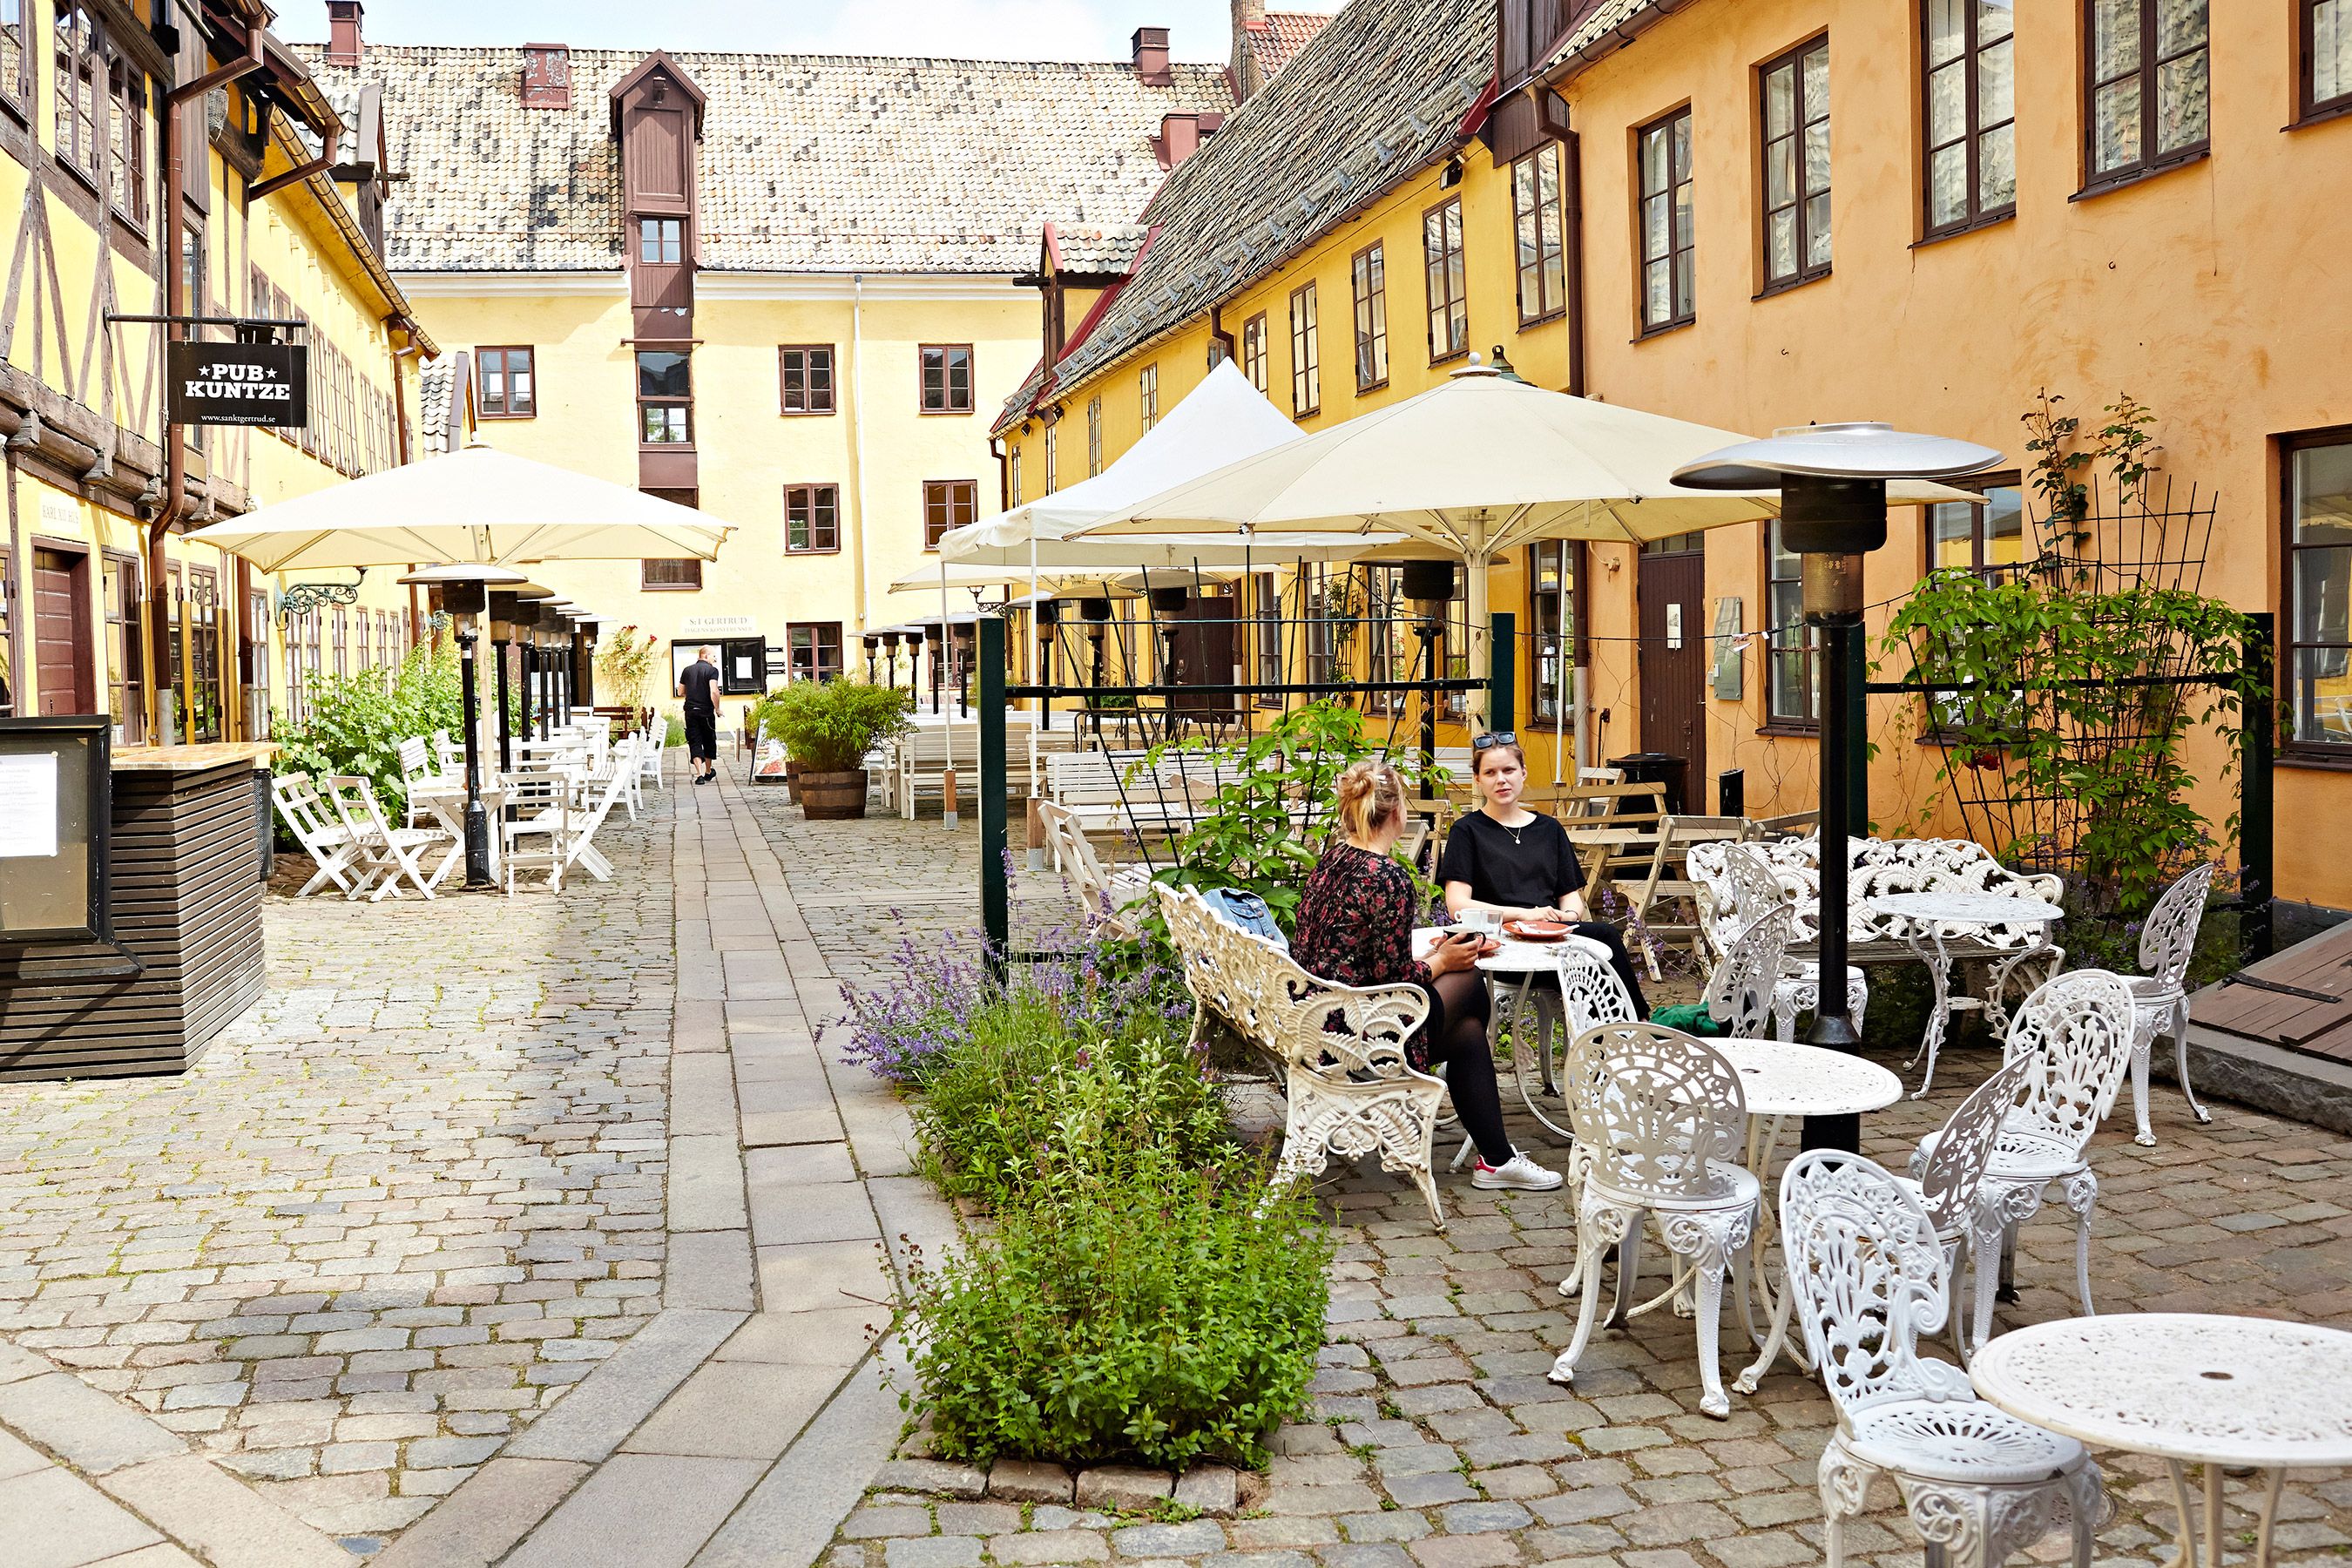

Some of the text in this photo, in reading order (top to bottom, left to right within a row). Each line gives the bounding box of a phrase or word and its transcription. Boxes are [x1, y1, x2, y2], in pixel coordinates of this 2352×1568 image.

[211, 363, 264, 382] PUB
[185, 381, 290, 401] KUNTZE
[200, 414, 276, 423] www.sanktgertrud.se
[704, 617, 747, 625] GERTRUD
